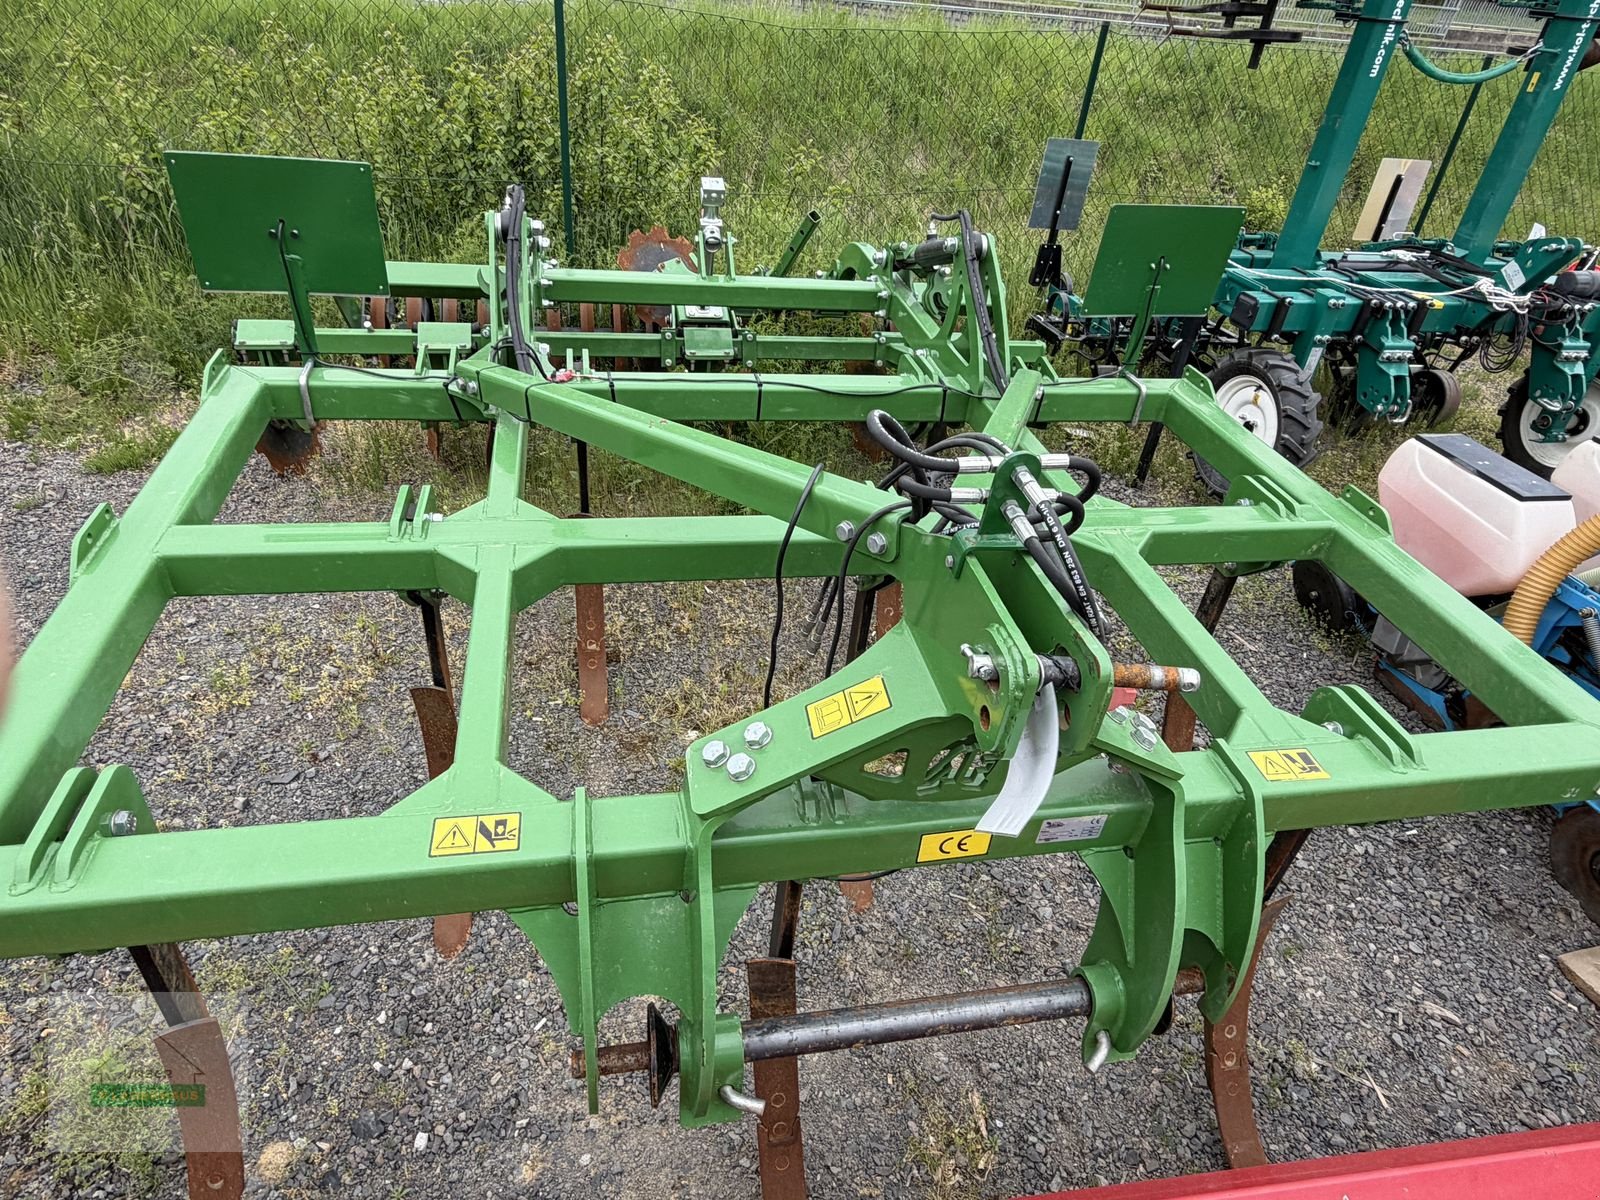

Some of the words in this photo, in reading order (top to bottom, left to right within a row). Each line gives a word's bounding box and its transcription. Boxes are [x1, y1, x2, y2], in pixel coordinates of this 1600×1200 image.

[1553, 0, 1600, 91] www.kol-tch
[1055, 534, 1066, 547] DN
[1062, 552, 1075, 569] 2SN
[1071, 569, 1082, 585] 853
[1077, 585, 1087, 597] EN
